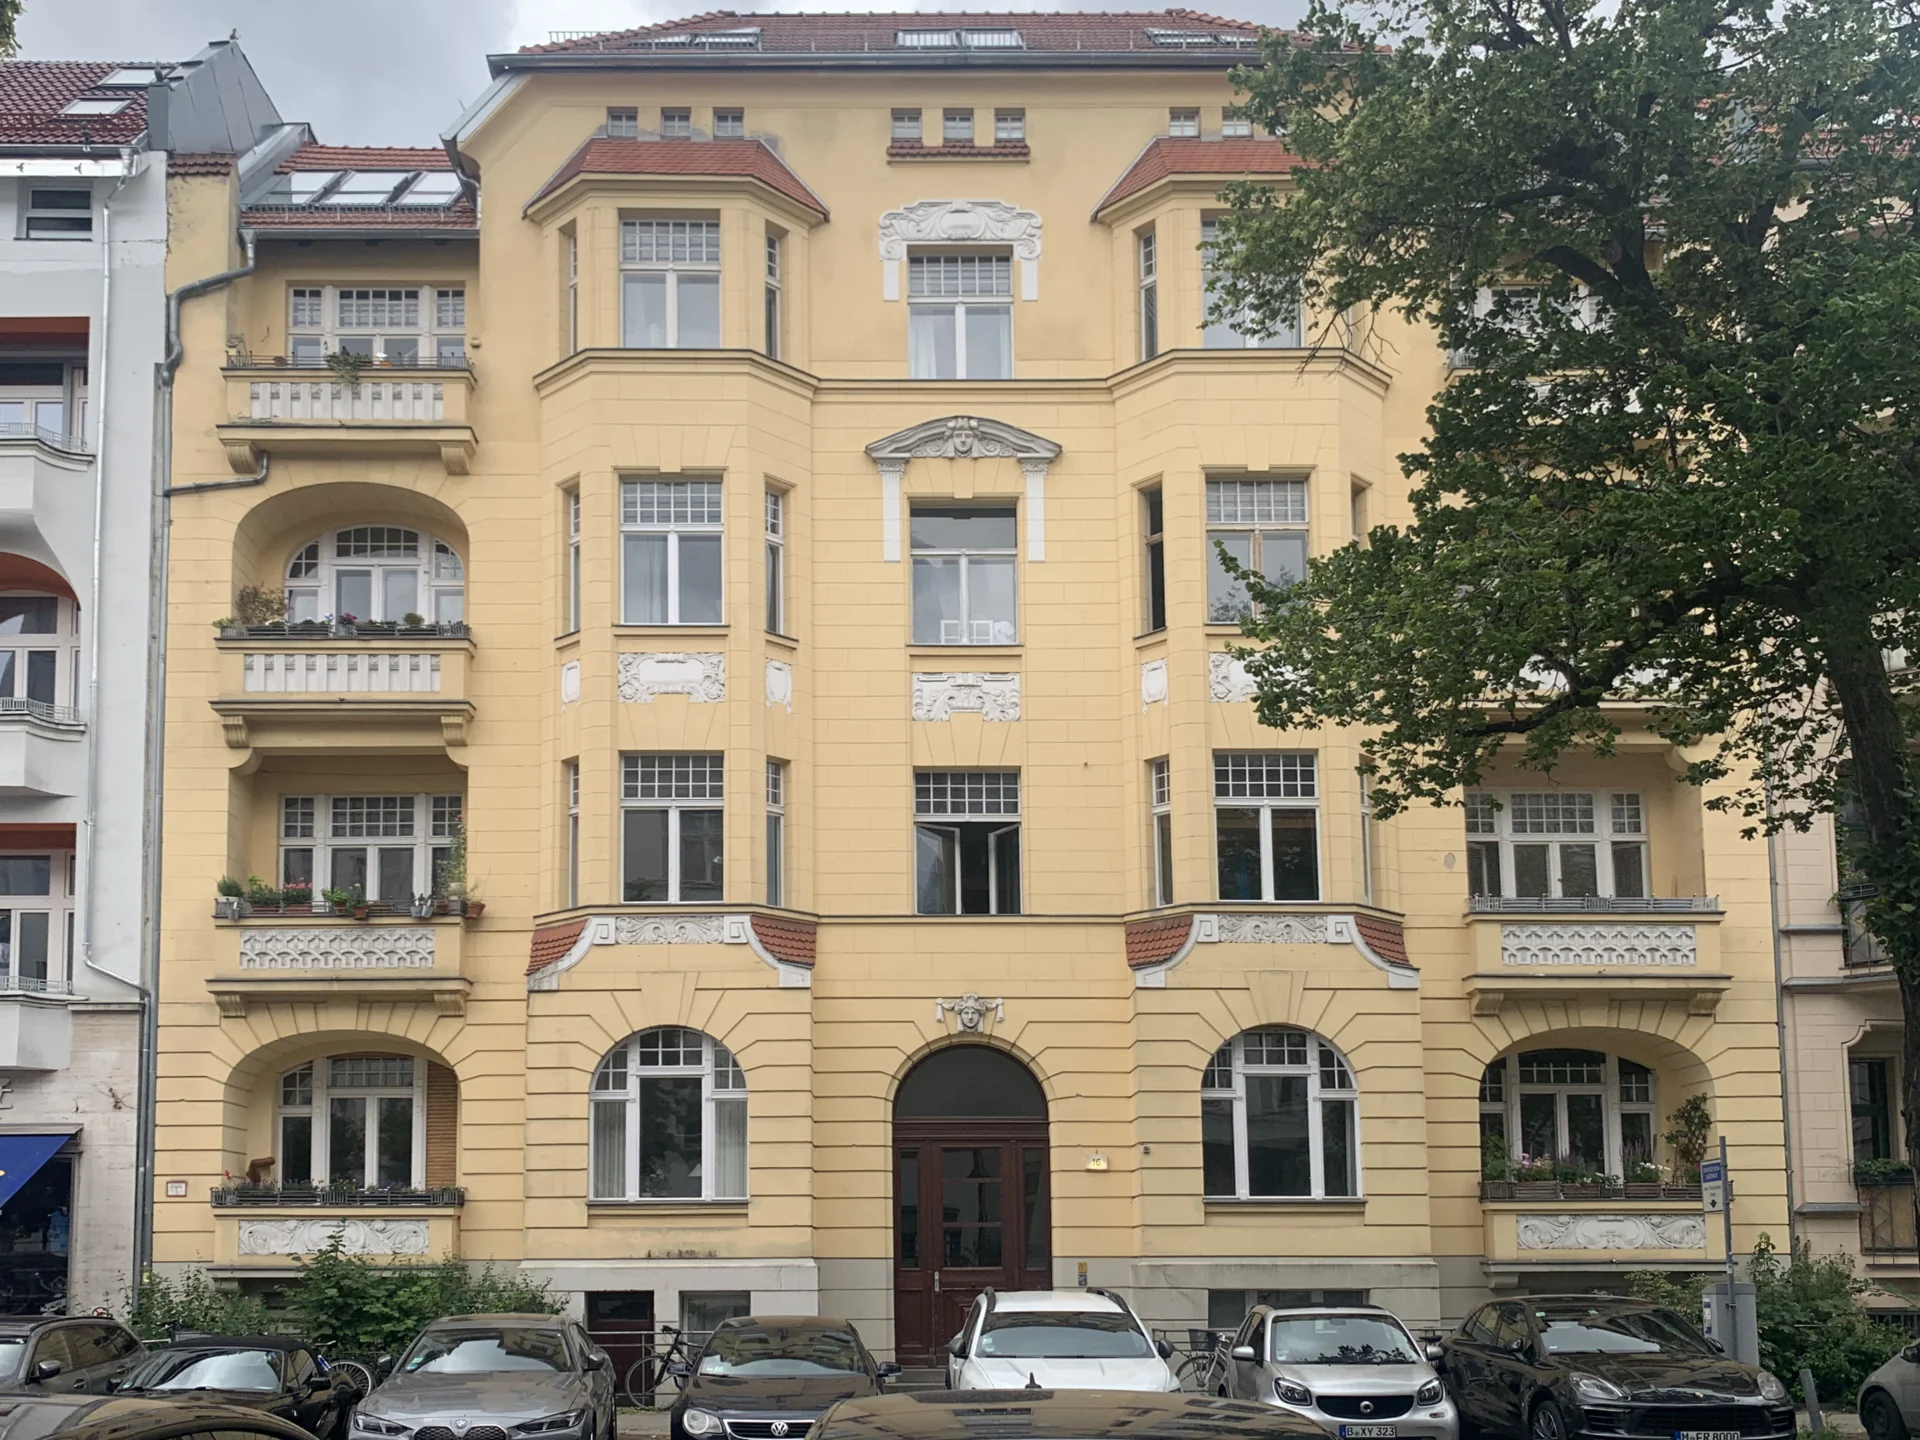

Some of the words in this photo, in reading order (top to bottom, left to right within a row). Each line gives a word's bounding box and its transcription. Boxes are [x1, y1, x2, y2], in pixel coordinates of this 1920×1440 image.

[1092, 1158, 1101, 1166] 16
[1361, 1427, 1373, 1436] XY
[1376, 1427, 1395, 1436] 323
